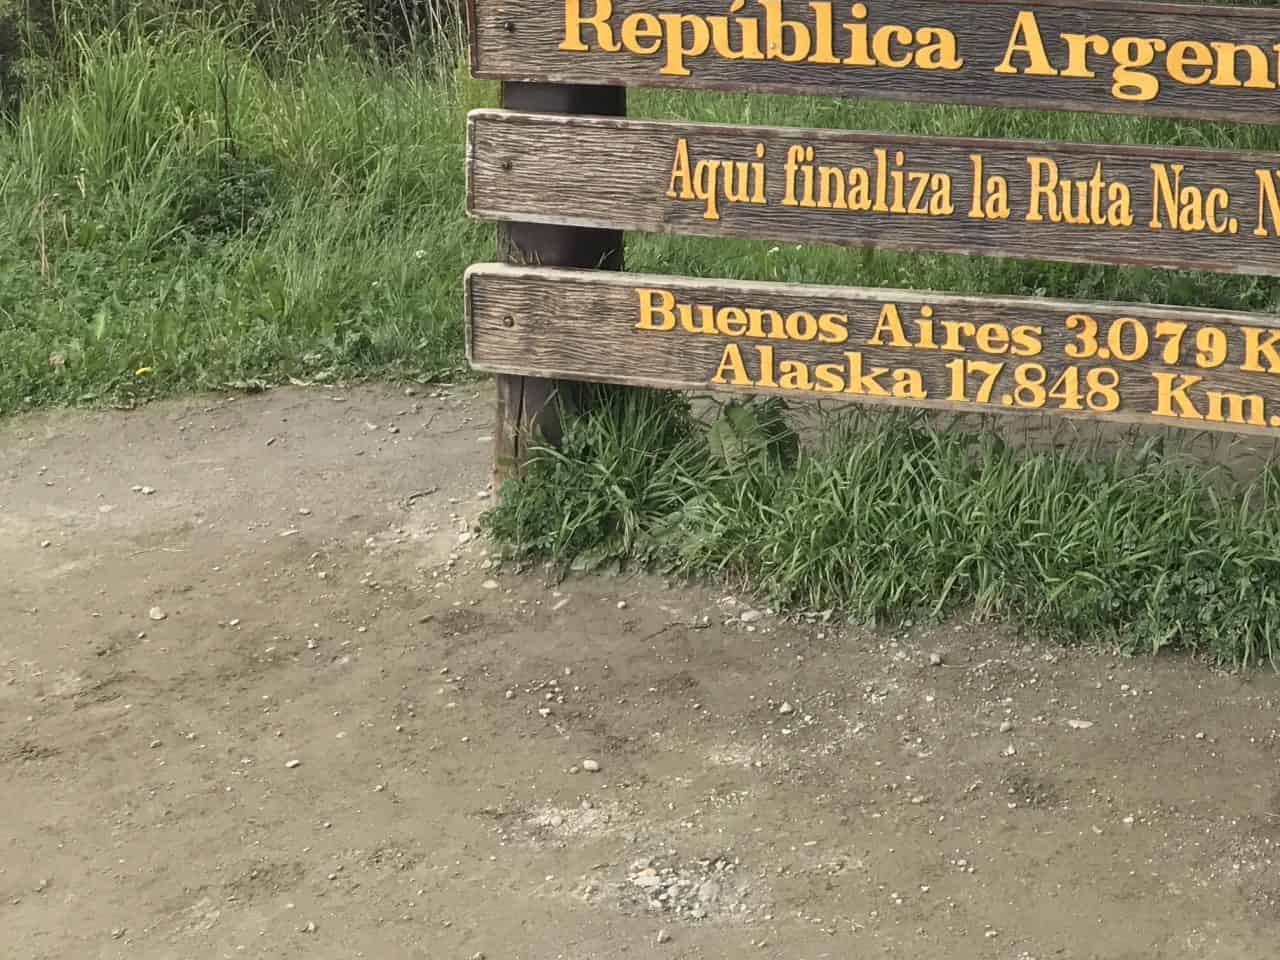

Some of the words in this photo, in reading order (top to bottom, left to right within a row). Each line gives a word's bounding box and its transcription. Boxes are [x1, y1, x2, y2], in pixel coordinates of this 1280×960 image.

[666, 138, 767, 221] Aqui
[781, 144, 954, 216] finaliza
[968, 154, 1011, 219] la
[1025, 155, 1133, 227] Ruta
[1148, 163, 1239, 234] Nac.
[634, 287, 849, 343] Buenos
[871, 303, 1043, 356] Aires
[710, 343, 927, 401] Alaska
[945, 358, 1121, 413] 17.848
